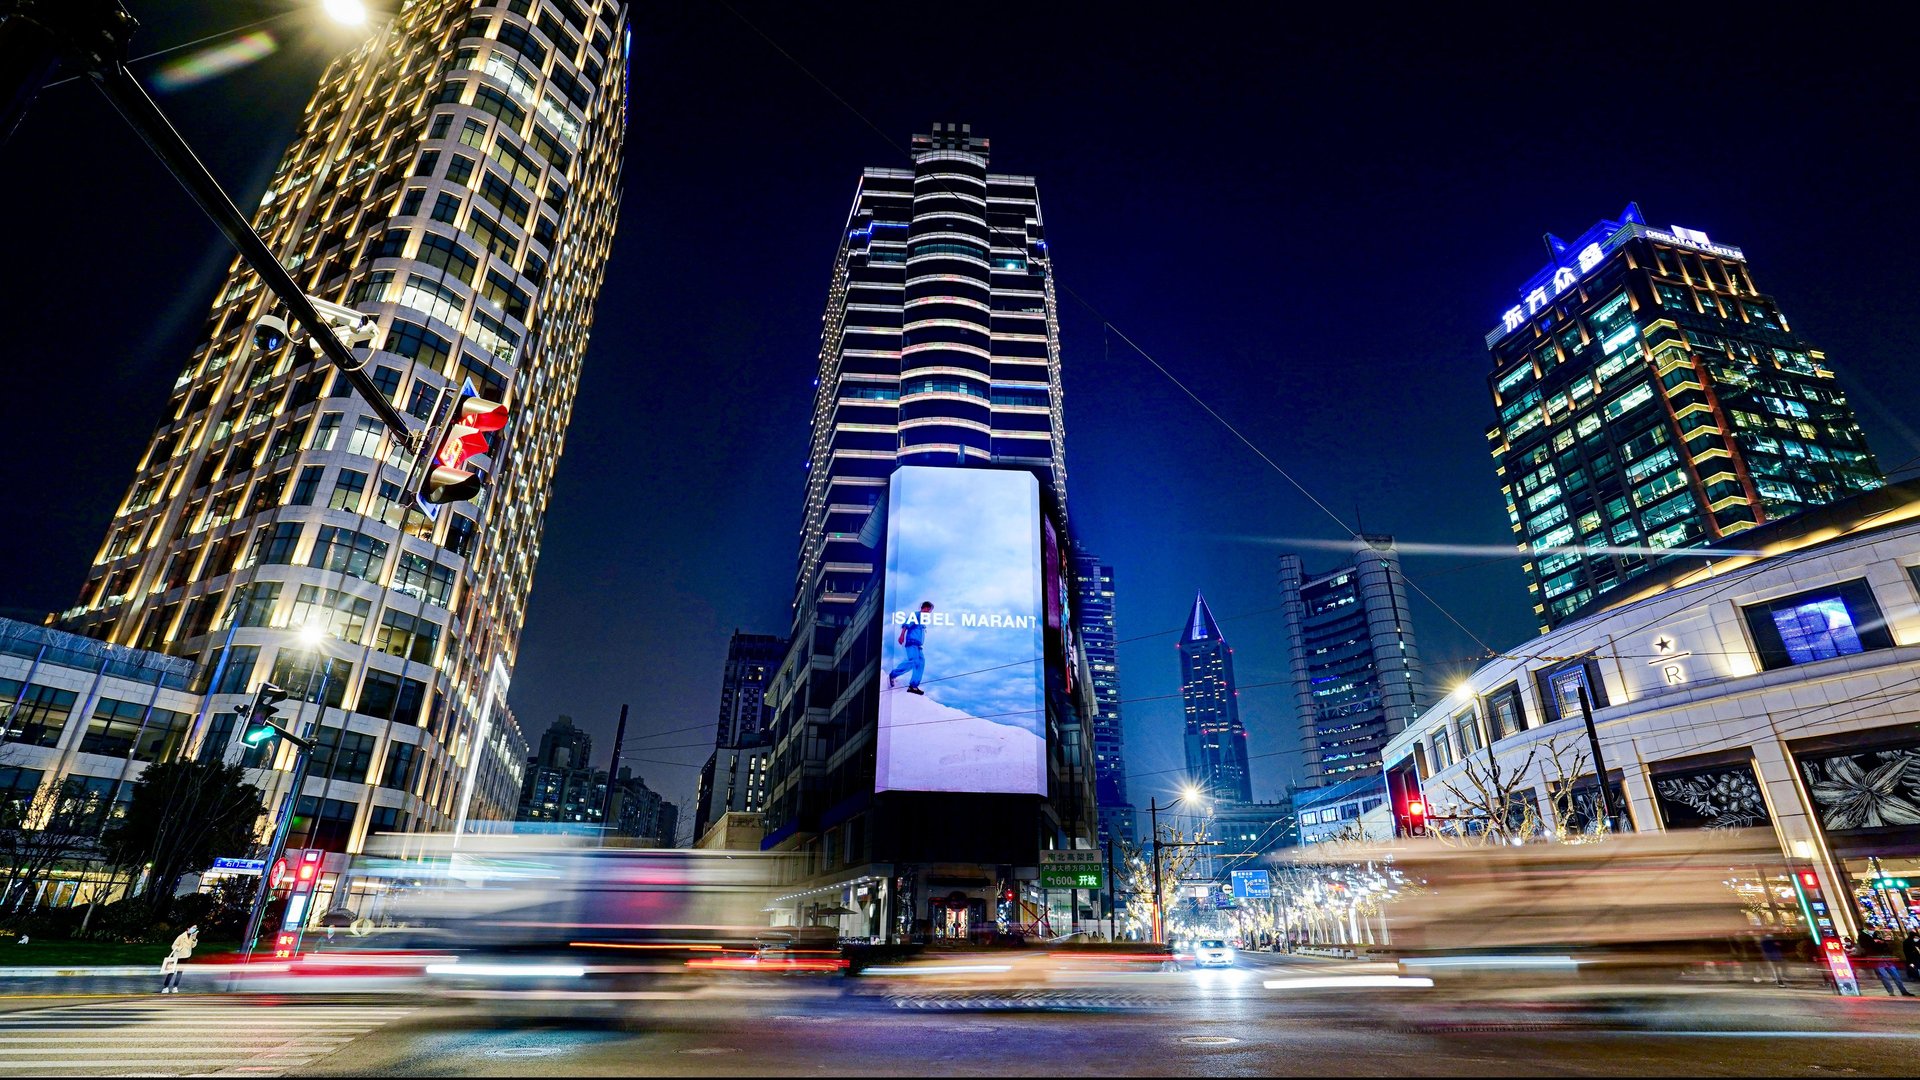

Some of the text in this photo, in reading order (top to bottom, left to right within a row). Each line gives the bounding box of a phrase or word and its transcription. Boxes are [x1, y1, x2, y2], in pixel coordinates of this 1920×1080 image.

[1502, 242, 1605, 334] 东方众鑫
[892, 611, 1036, 629] ISABEL MARANT
[1664, 665, 1683, 683] R
[1047, 853, 1095, 862] 南北高架路
[1078, 875, 1097, 886] 开放
